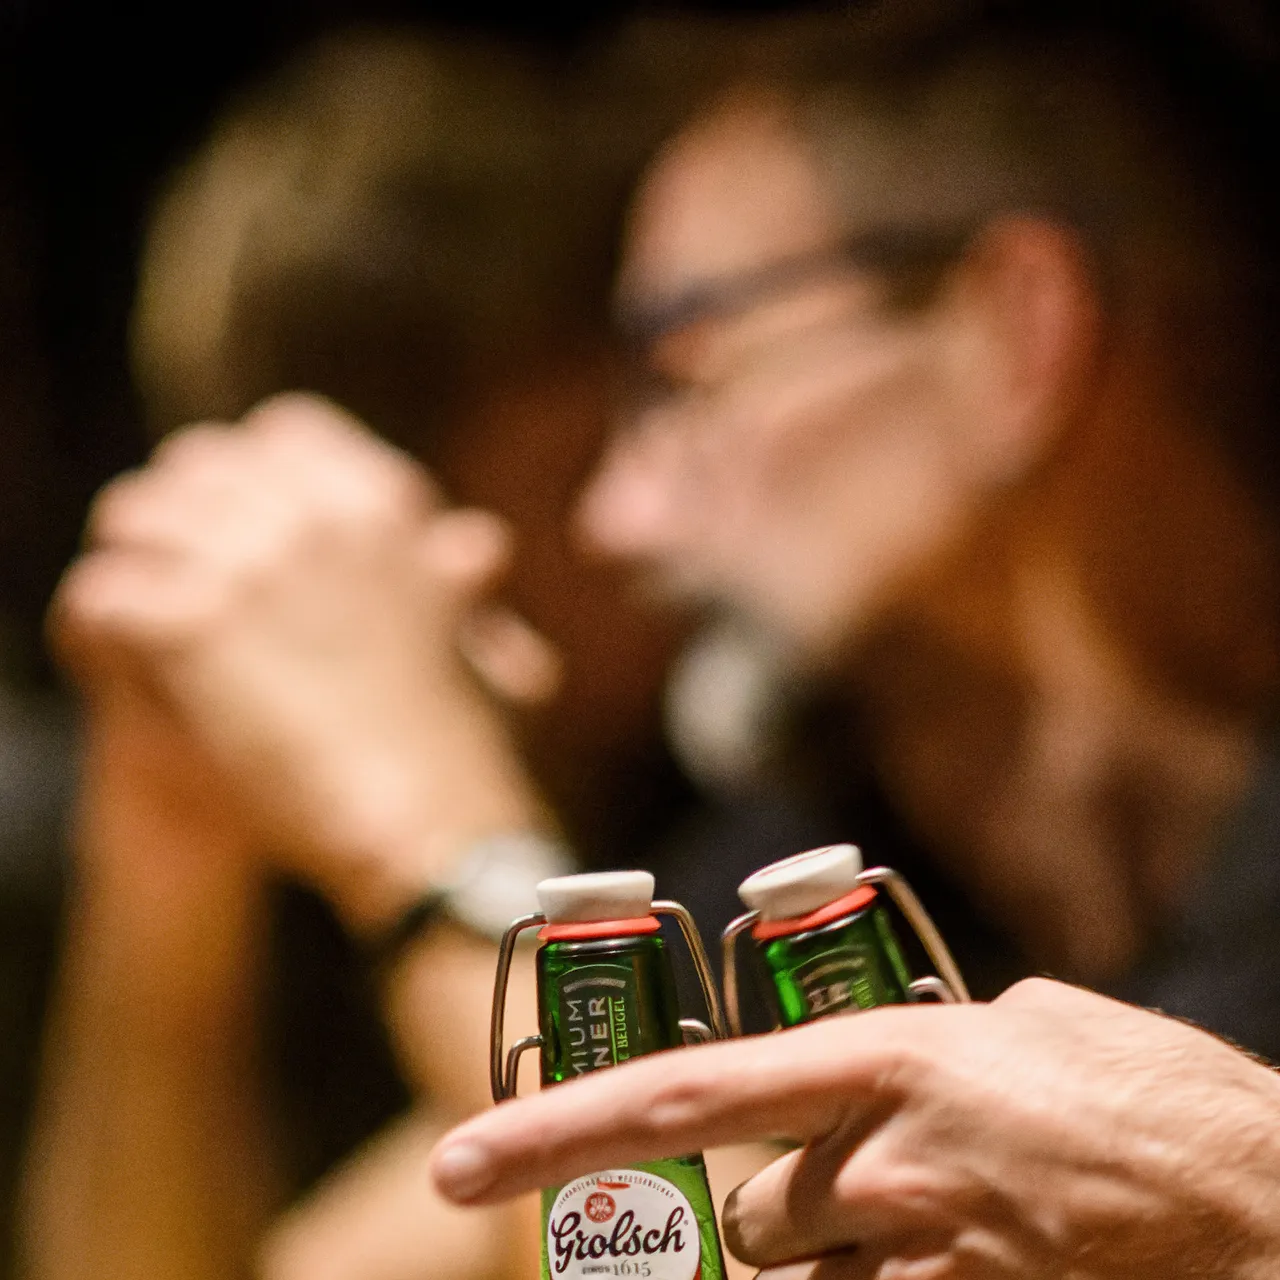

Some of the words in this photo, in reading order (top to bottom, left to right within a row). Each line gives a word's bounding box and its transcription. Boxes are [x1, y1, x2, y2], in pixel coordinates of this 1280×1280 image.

[613, 996, 629, 1048] BEUGEL
[551, 1205, 686, 1274] Grolsch
[613, 1259, 652, 1278] 1615
